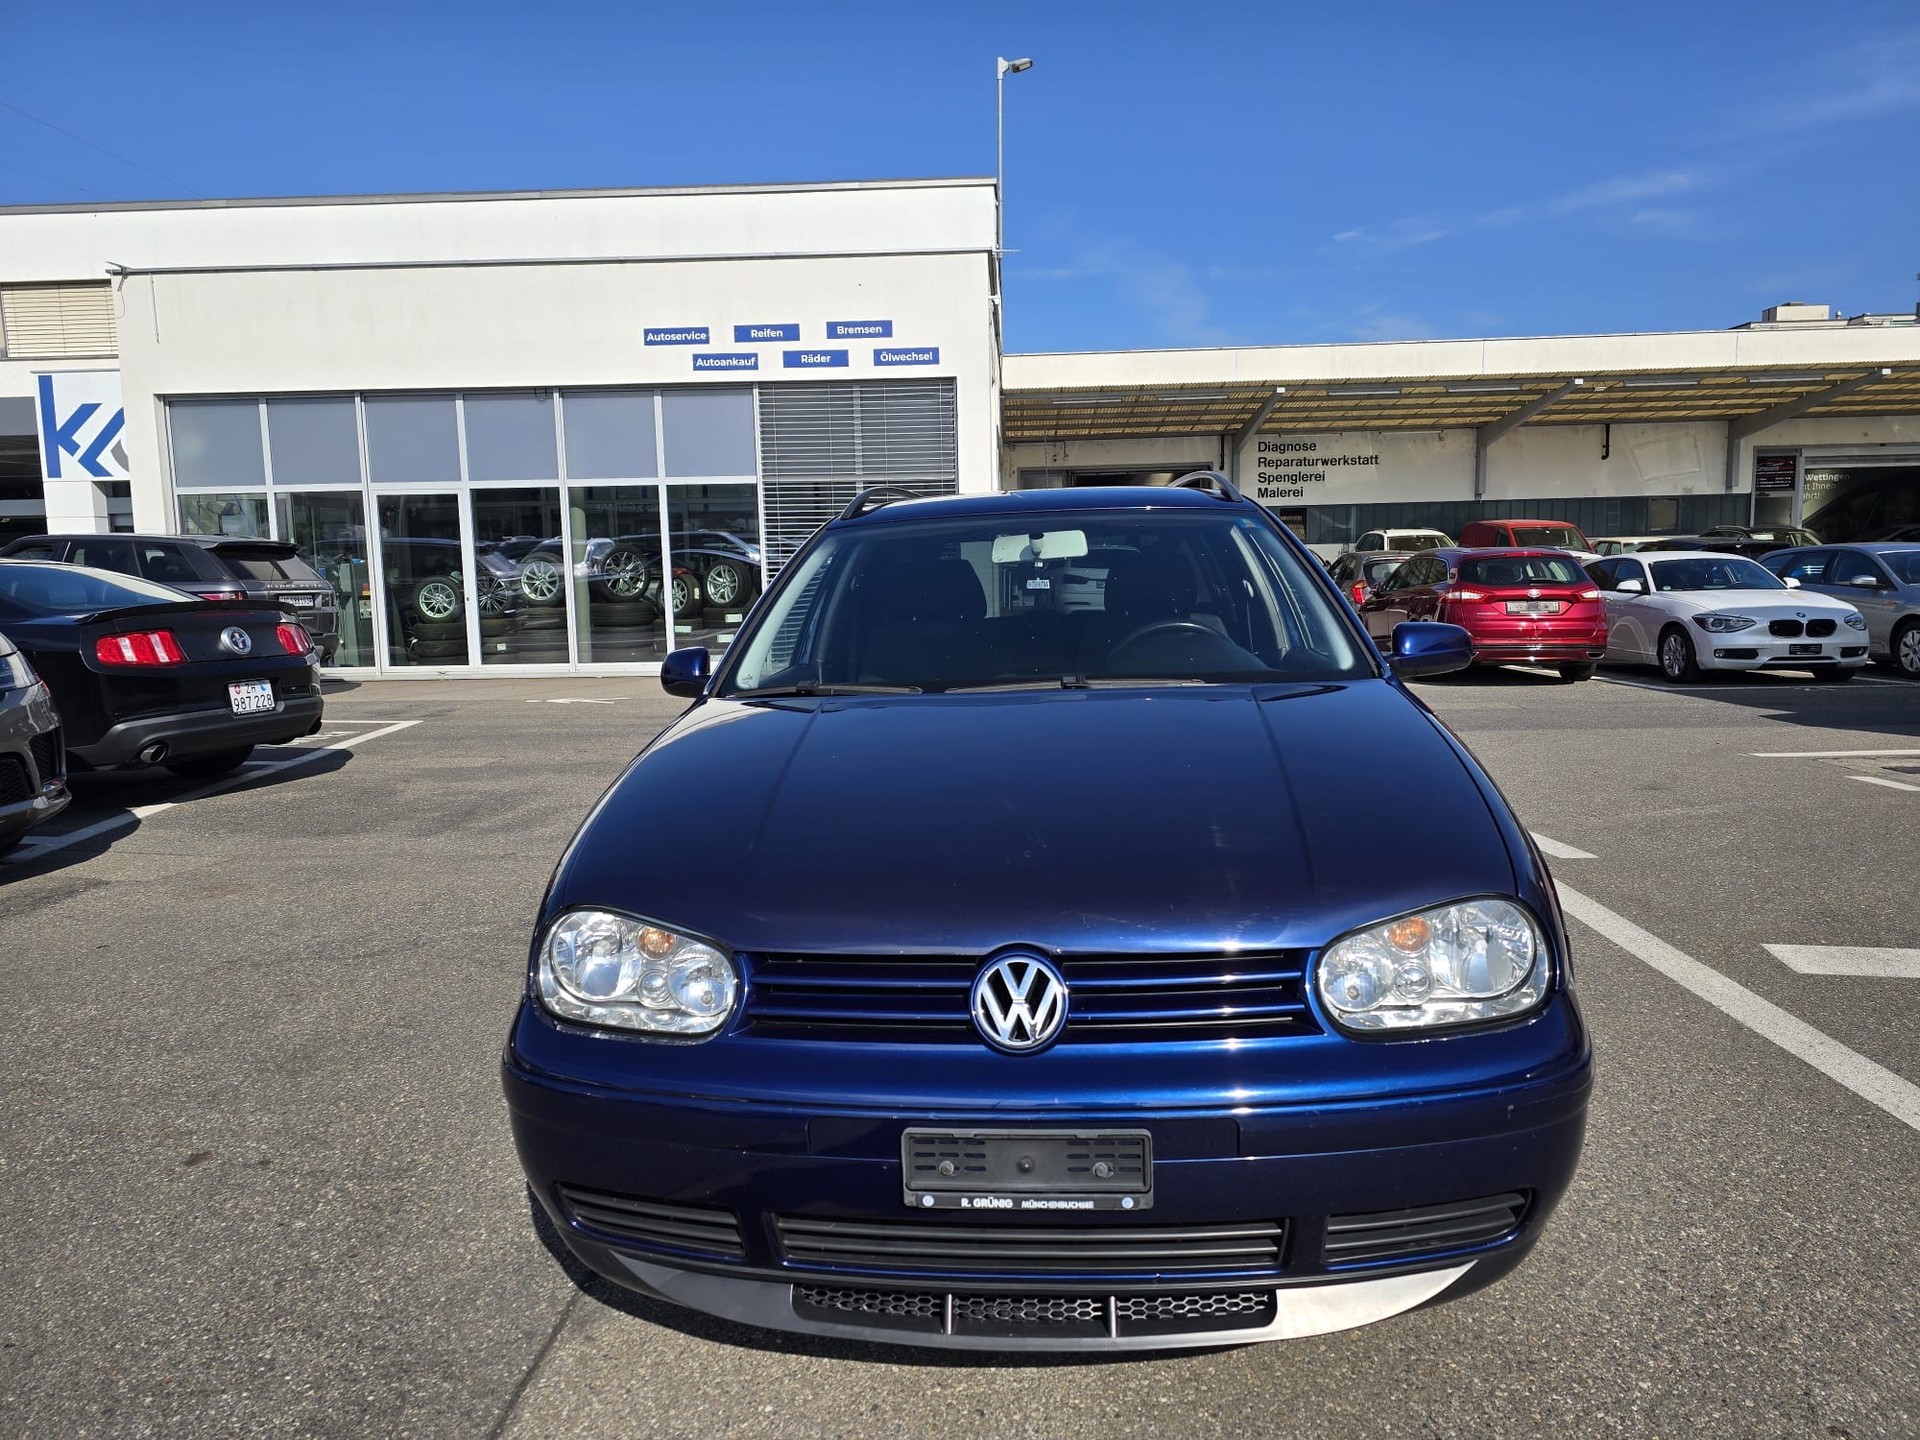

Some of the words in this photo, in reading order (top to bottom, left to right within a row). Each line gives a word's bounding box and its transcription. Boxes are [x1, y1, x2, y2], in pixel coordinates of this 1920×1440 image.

[646, 330, 707, 341] Autoservice
[750, 328, 784, 339] Reifen
[836, 325, 883, 335] Bremsen
[695, 357, 756, 367] Autoankauf
[801, 353, 831, 364] Räder
[880, 351, 933, 362] Ölwechsel
[1257, 441, 1317, 454] Diagnose
[1257, 455, 1379, 469] Reparaturwerkstatt
[1257, 470, 1326, 485] Spenglerei
[1257, 487, 1304, 498] Malerei
[233, 696, 252, 711] 987
[254, 693, 273, 708] 228
[961, 1198, 971, 1208] R.
[973, 1196, 1013, 1209] GRÜNIG
